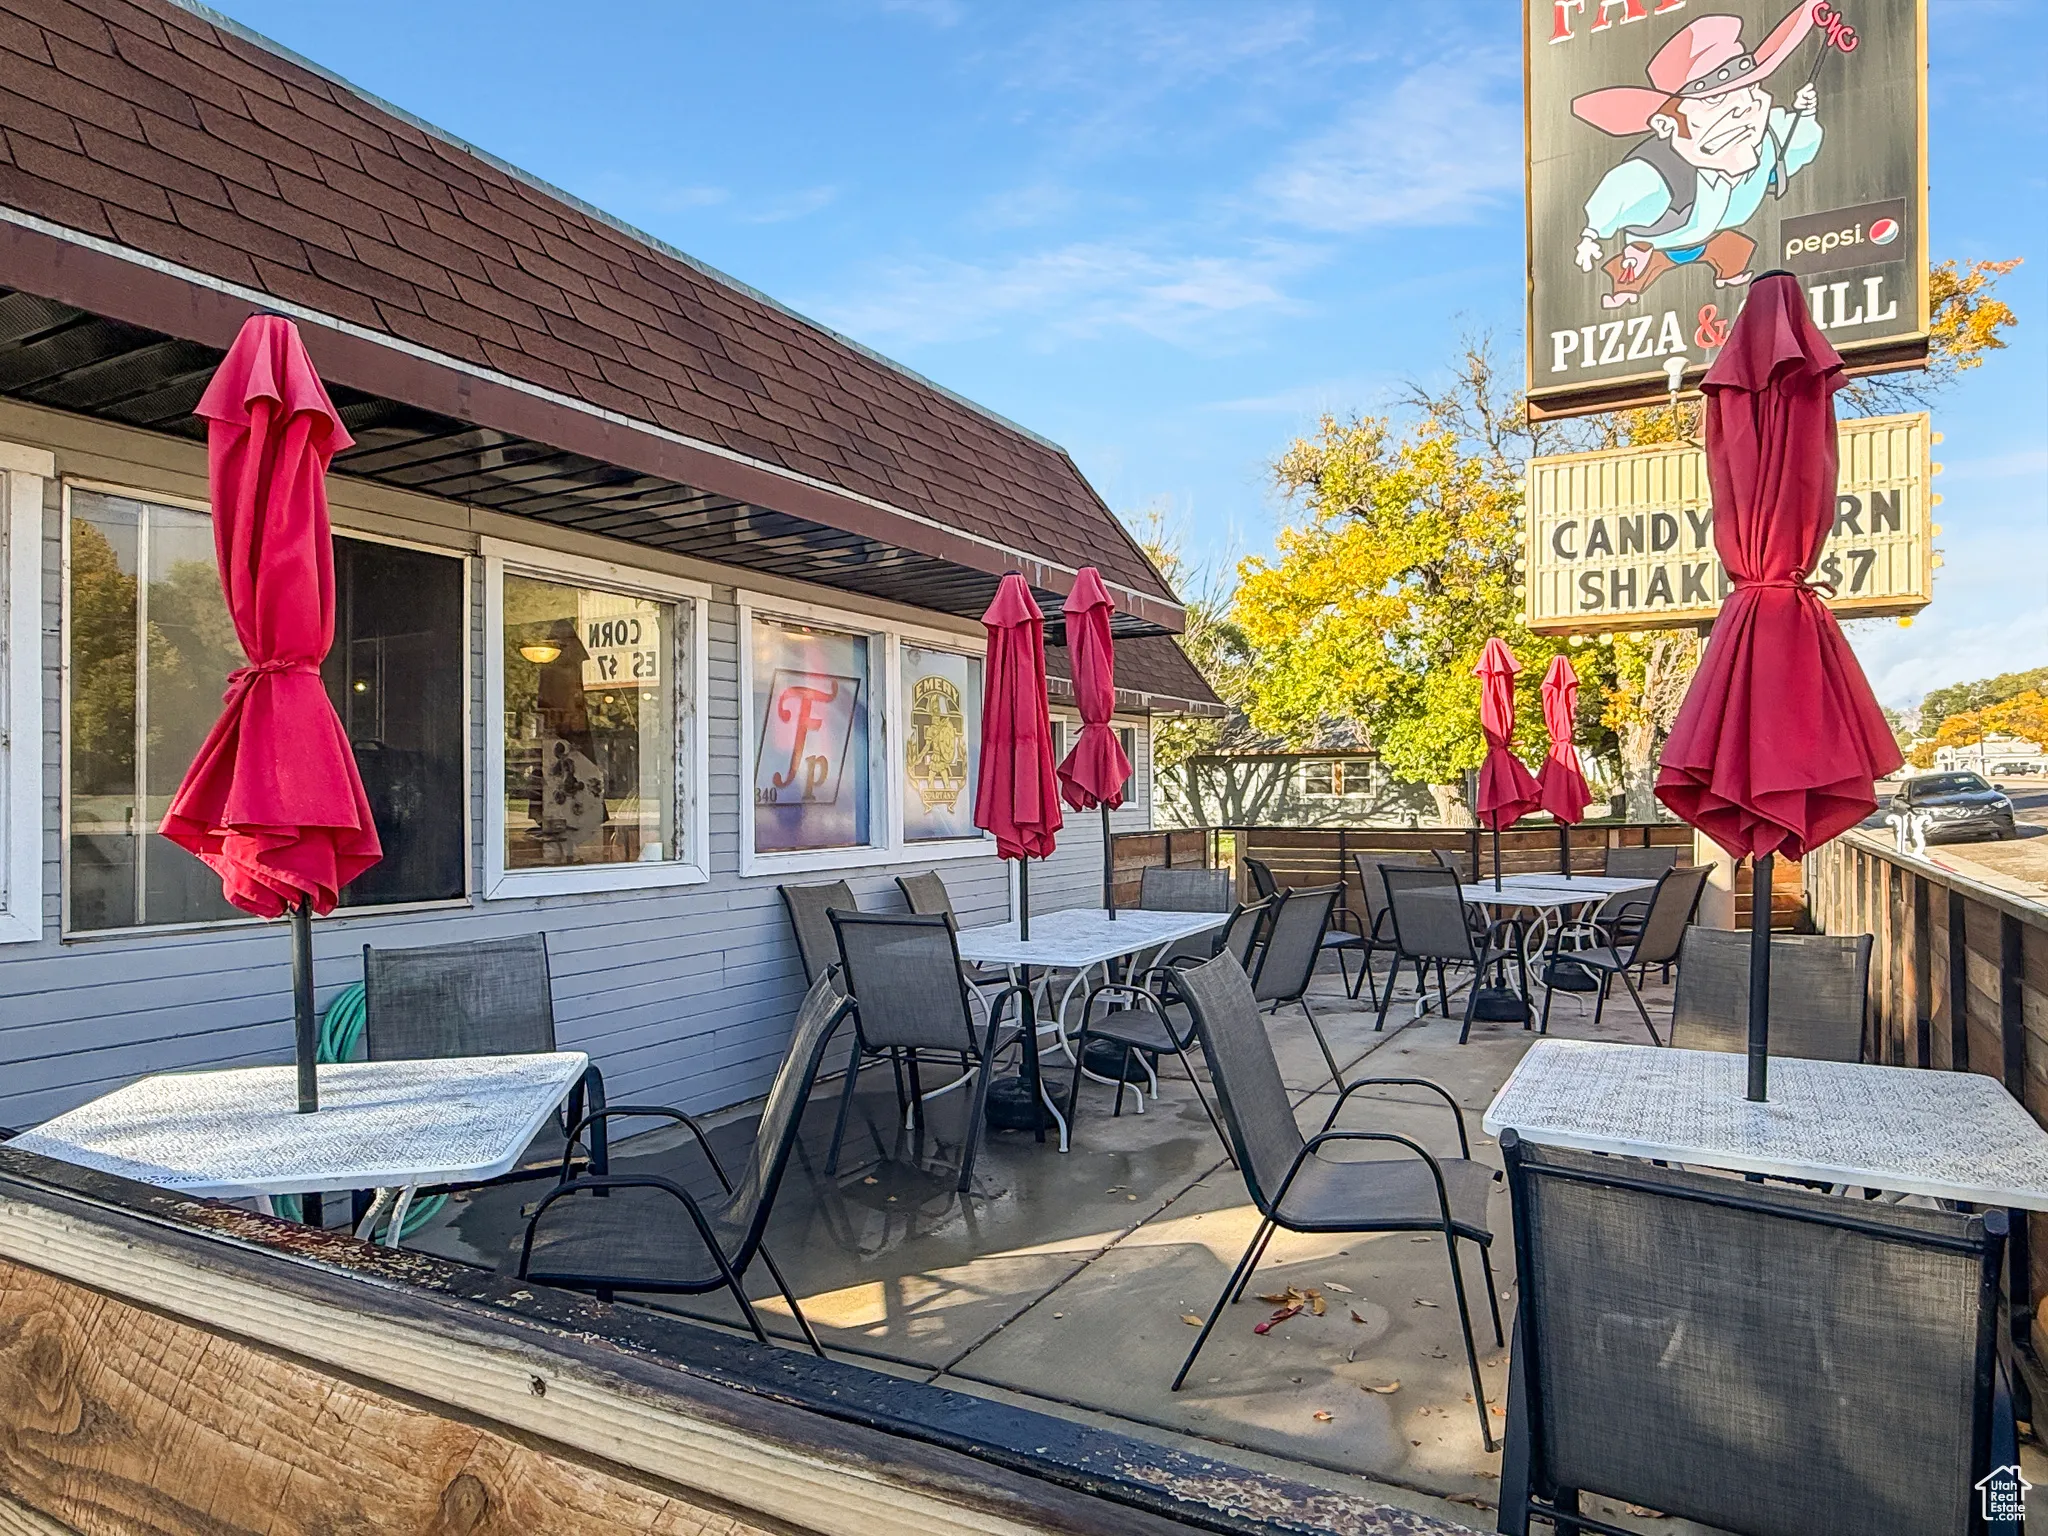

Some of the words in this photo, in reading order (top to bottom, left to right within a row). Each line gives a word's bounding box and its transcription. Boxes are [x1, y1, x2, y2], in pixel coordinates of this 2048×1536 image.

[1785, 223, 1861, 261] pepsi
[1550, 310, 1688, 373] PIZZA
[1694, 303, 1732, 349] &
[1552, 508, 1712, 560] CANDY
[1820, 548, 1877, 594] $7
[914, 678, 960, 702] EMERY
